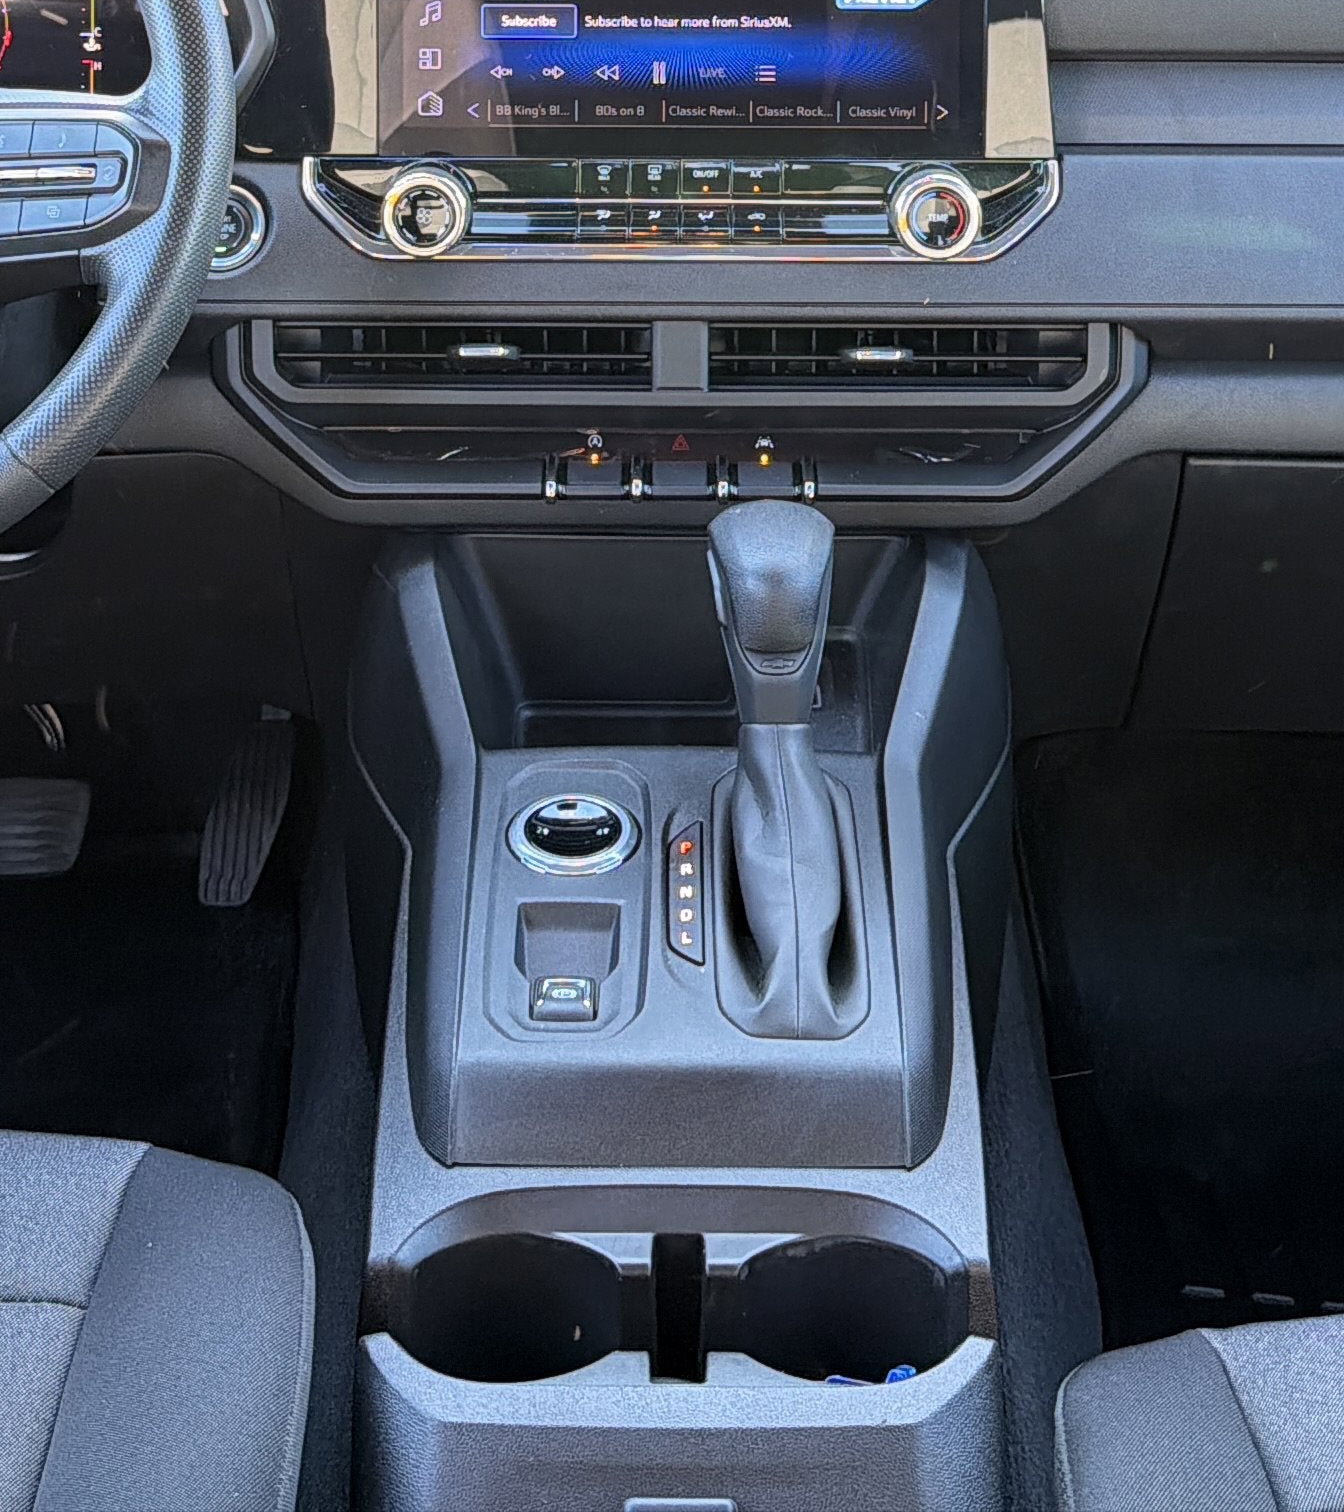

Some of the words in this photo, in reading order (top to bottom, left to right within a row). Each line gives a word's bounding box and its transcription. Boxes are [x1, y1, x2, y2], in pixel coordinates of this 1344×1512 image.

[501, 14, 557, 29] Subscribe
[584, 15, 638, 29] Subscribe
[640, 16, 652, 29] to
[654, 15, 679, 29] hear
[681, 18, 711, 29] more
[712, 15, 738, 29] from
[740, 15, 792, 29] SiriusXM.
[514, 103, 547, 119] King's
[619, 107, 634, 116] on
[668, 104, 707, 117] Classic
[756, 105, 794, 117] Classic
[849, 105, 886, 118] Classic
[888, 106, 916, 120] Vinyl
[680, 841, 693, 855] P
[680, 862, 694, 875] R
[679, 885, 693, 898] N
[680, 908, 693, 921] D
[681, 931, 692, 945] L
